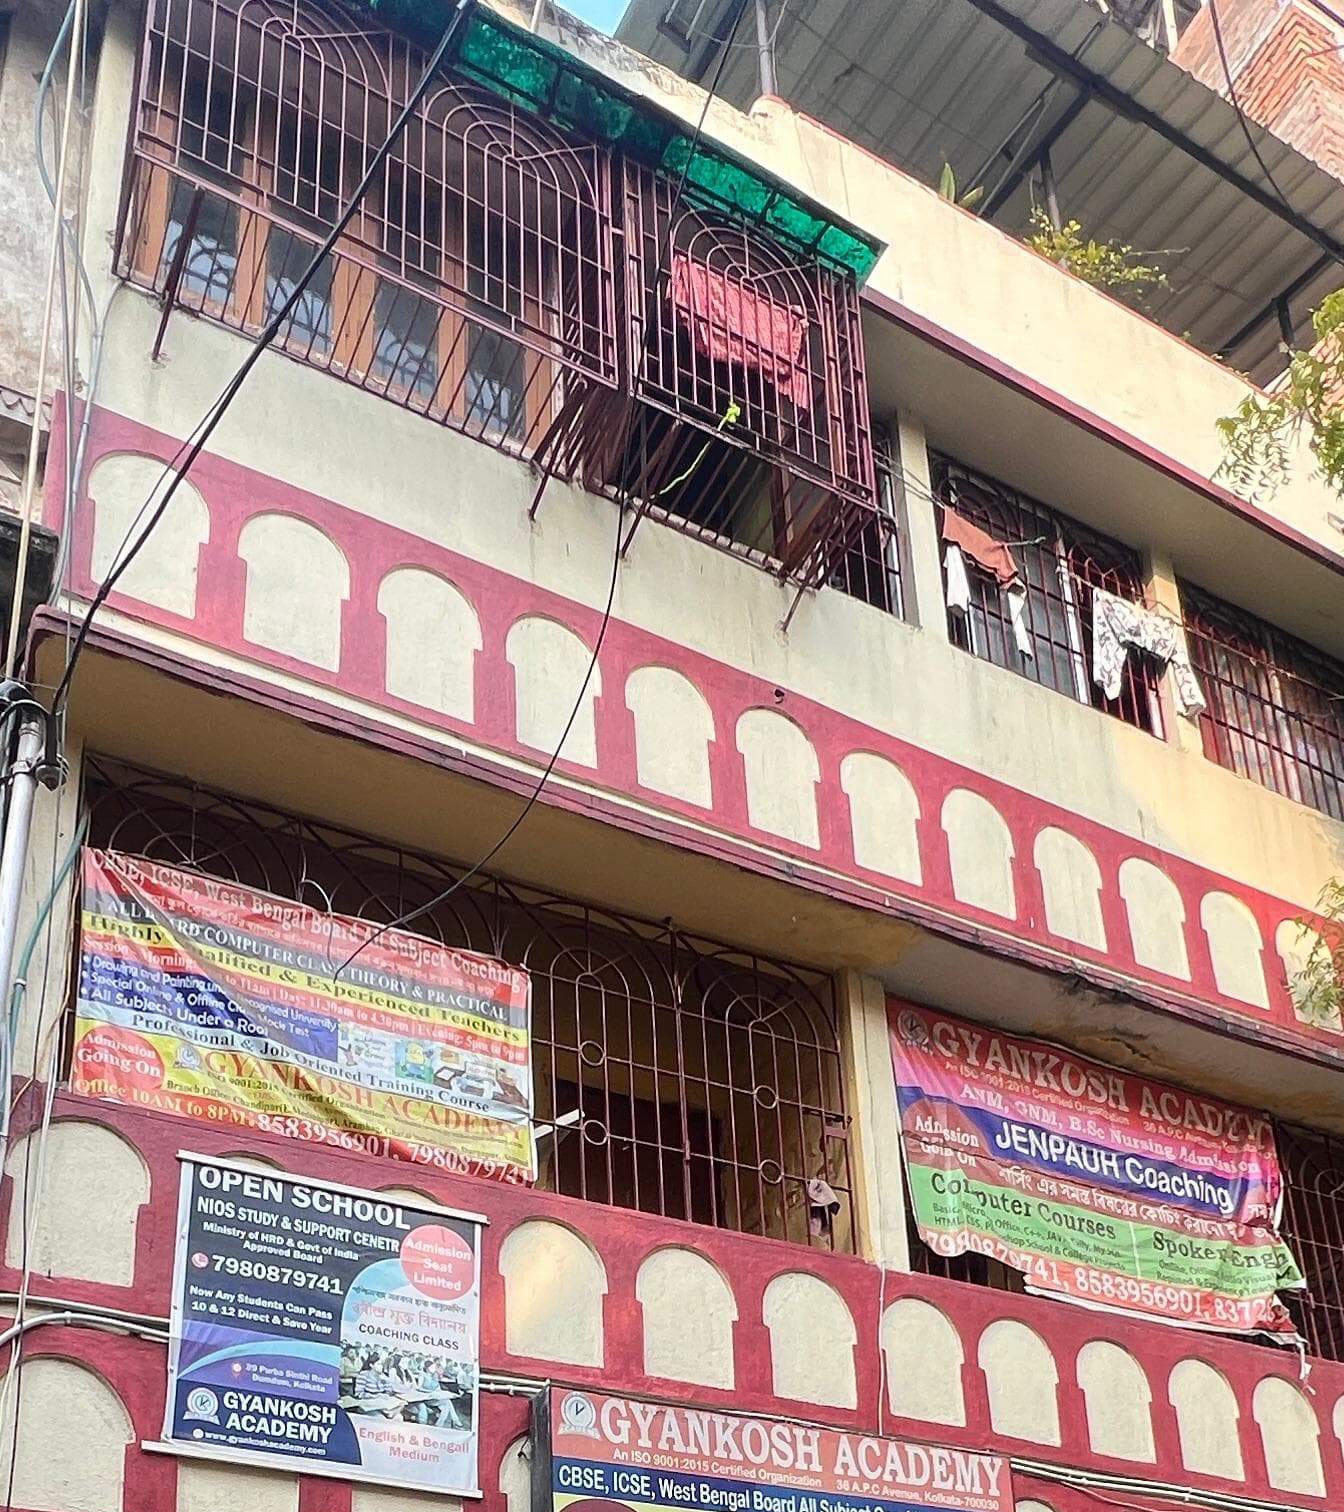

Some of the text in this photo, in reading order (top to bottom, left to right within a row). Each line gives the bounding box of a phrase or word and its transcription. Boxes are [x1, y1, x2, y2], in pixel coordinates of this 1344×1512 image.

[204, 926, 293, 965] COMPUTER
[932, 1021, 1130, 1113] GYANKOSH
[996, 1121, 1235, 1214] JENPAUH Coaching
[198, 1166, 411, 1230] OPEN SCHOOL
[197, 1196, 400, 1252] NIOS STUDY & SUPPORT CENETR
[1037, 1202, 1117, 1240] Courses
[405, 1239, 472, 1260] Admission
[212, 1255, 344, 1295] 7980879741
[414, 1271, 462, 1292] Limited
[358, 1323, 459, 1351] COACHING CLASS
[223, 1391, 337, 1425] GYANKOSH
[225, 1412, 333, 1444] ACADEMY
[601, 1397, 1003, 1496] GYANKOSH ACADEMY
[559, 1464, 611, 1494] CBSE,
[613, 1471, 656, 1500] ICSE,
[659, 1477, 696, 1502] West
[700, 1483, 750, 1511] Bengal
[613, 1448, 629, 1461] An
[631, 1451, 651, 1464] ISO
[711, 1461, 756, 1479] Certified
[758, 1467, 822, 1488] Organization
